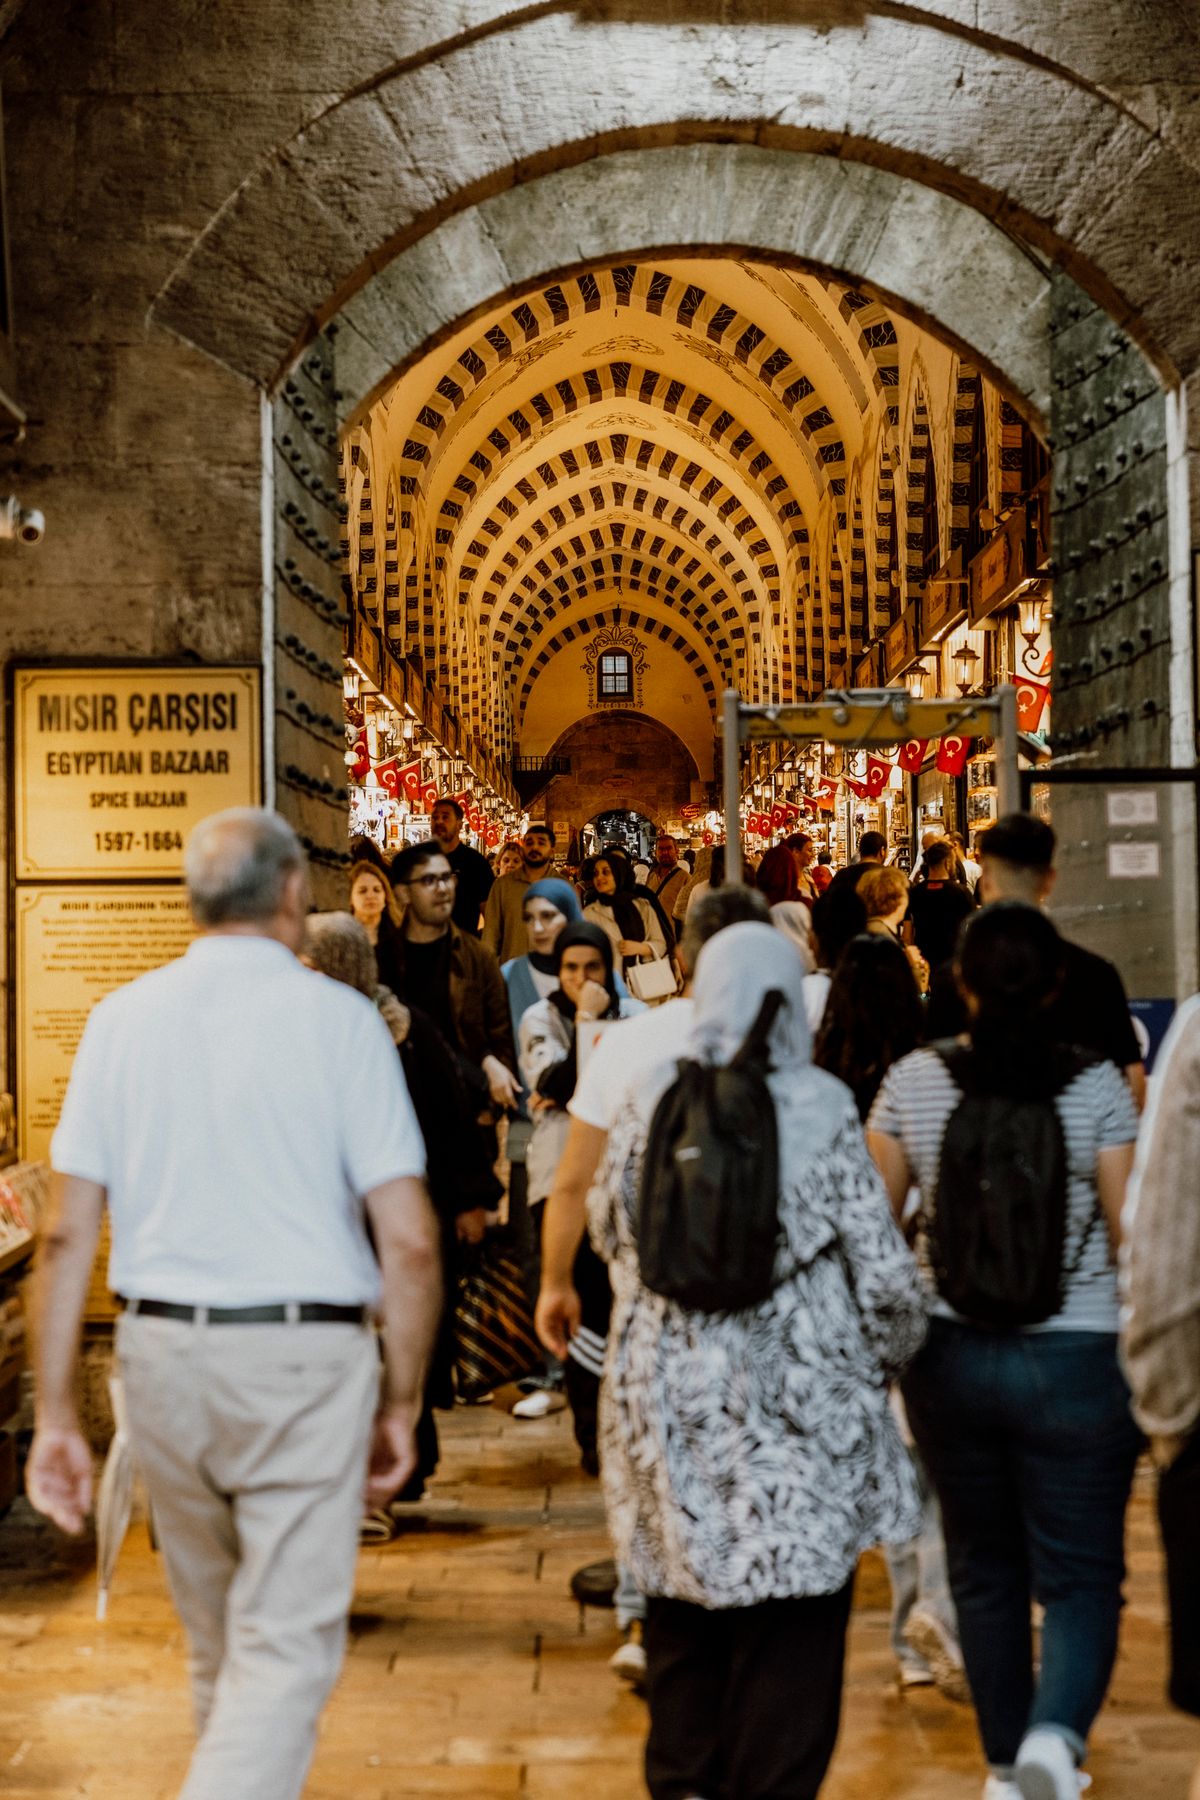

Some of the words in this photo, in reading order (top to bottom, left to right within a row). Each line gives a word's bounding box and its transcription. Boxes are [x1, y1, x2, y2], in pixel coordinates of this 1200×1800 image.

[38, 694, 117, 731] MISIR
[128, 692, 237, 736] ÇARŞISI
[47, 751, 143, 775] EGYPTIAN
[150, 750, 229, 774] BAZAAR
[90, 792, 128, 808] SPICE
[133, 791, 187, 808] BAZAAR
